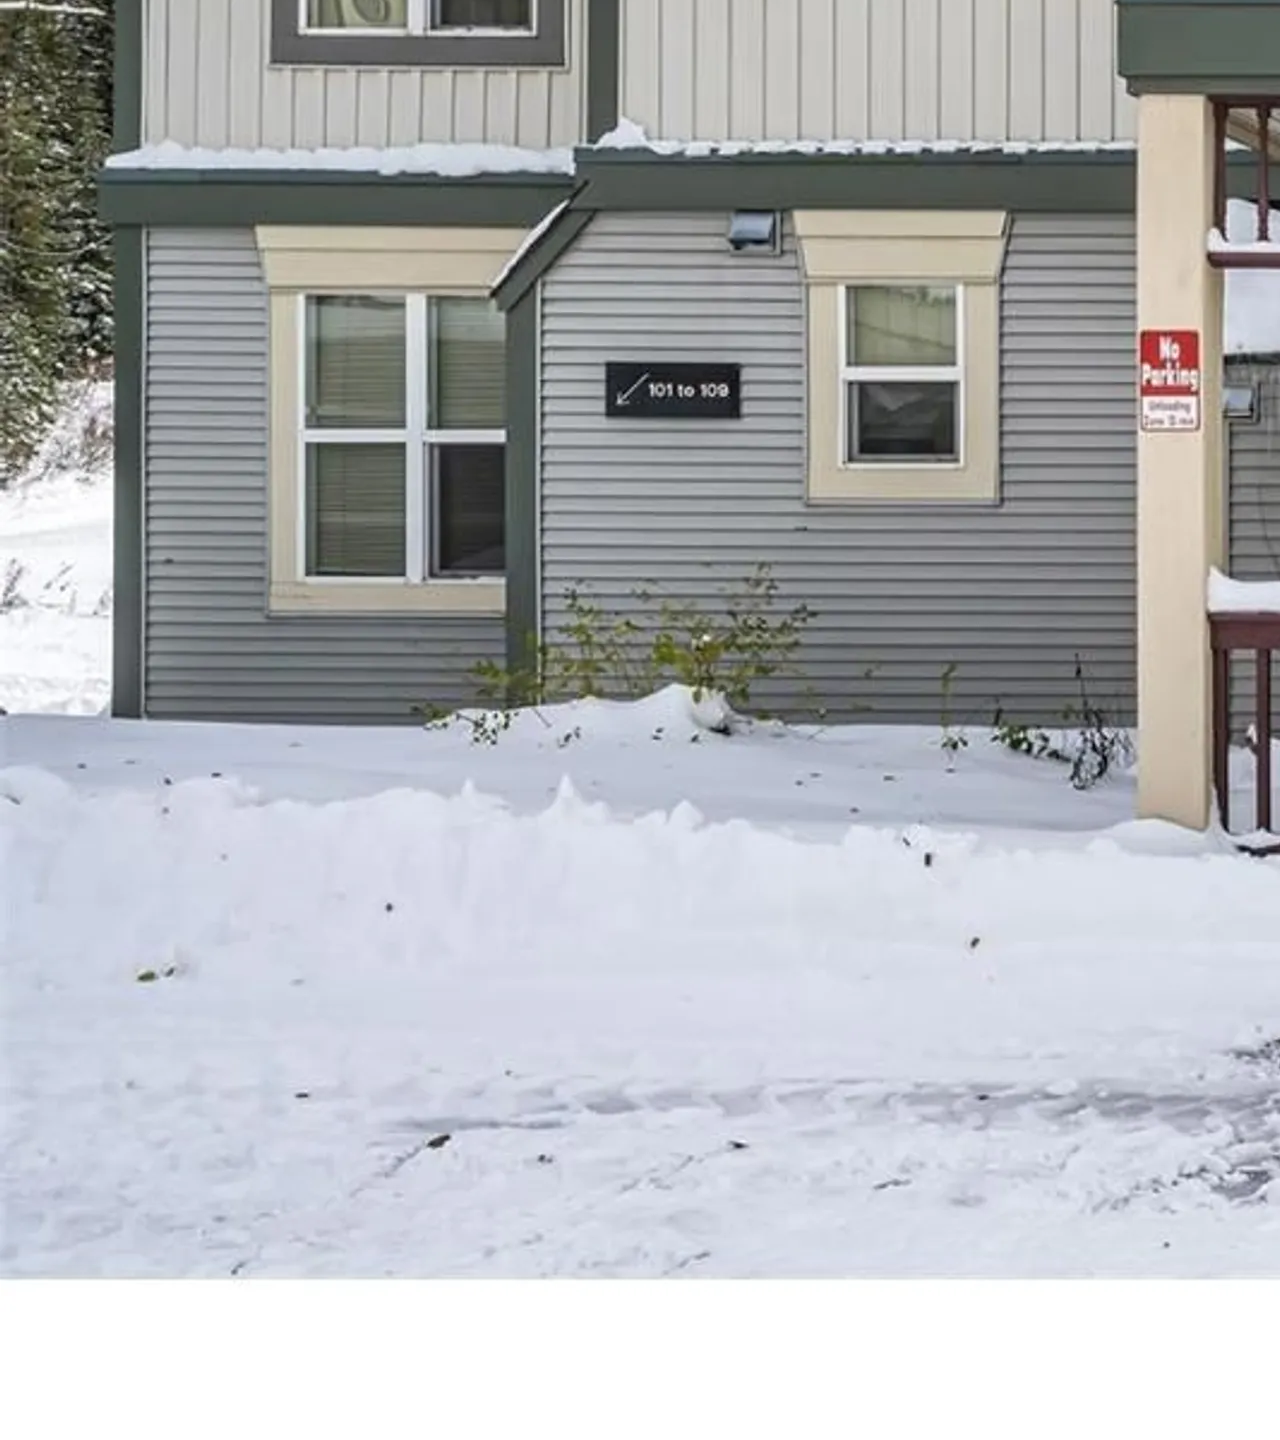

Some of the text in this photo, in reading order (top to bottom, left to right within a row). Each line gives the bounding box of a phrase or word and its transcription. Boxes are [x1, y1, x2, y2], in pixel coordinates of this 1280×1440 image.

[1159, 335, 1180, 361] No
[648, 382, 673, 398] 101
[676, 382, 695, 398] to
[1142, 361, 1199, 393] Parking
